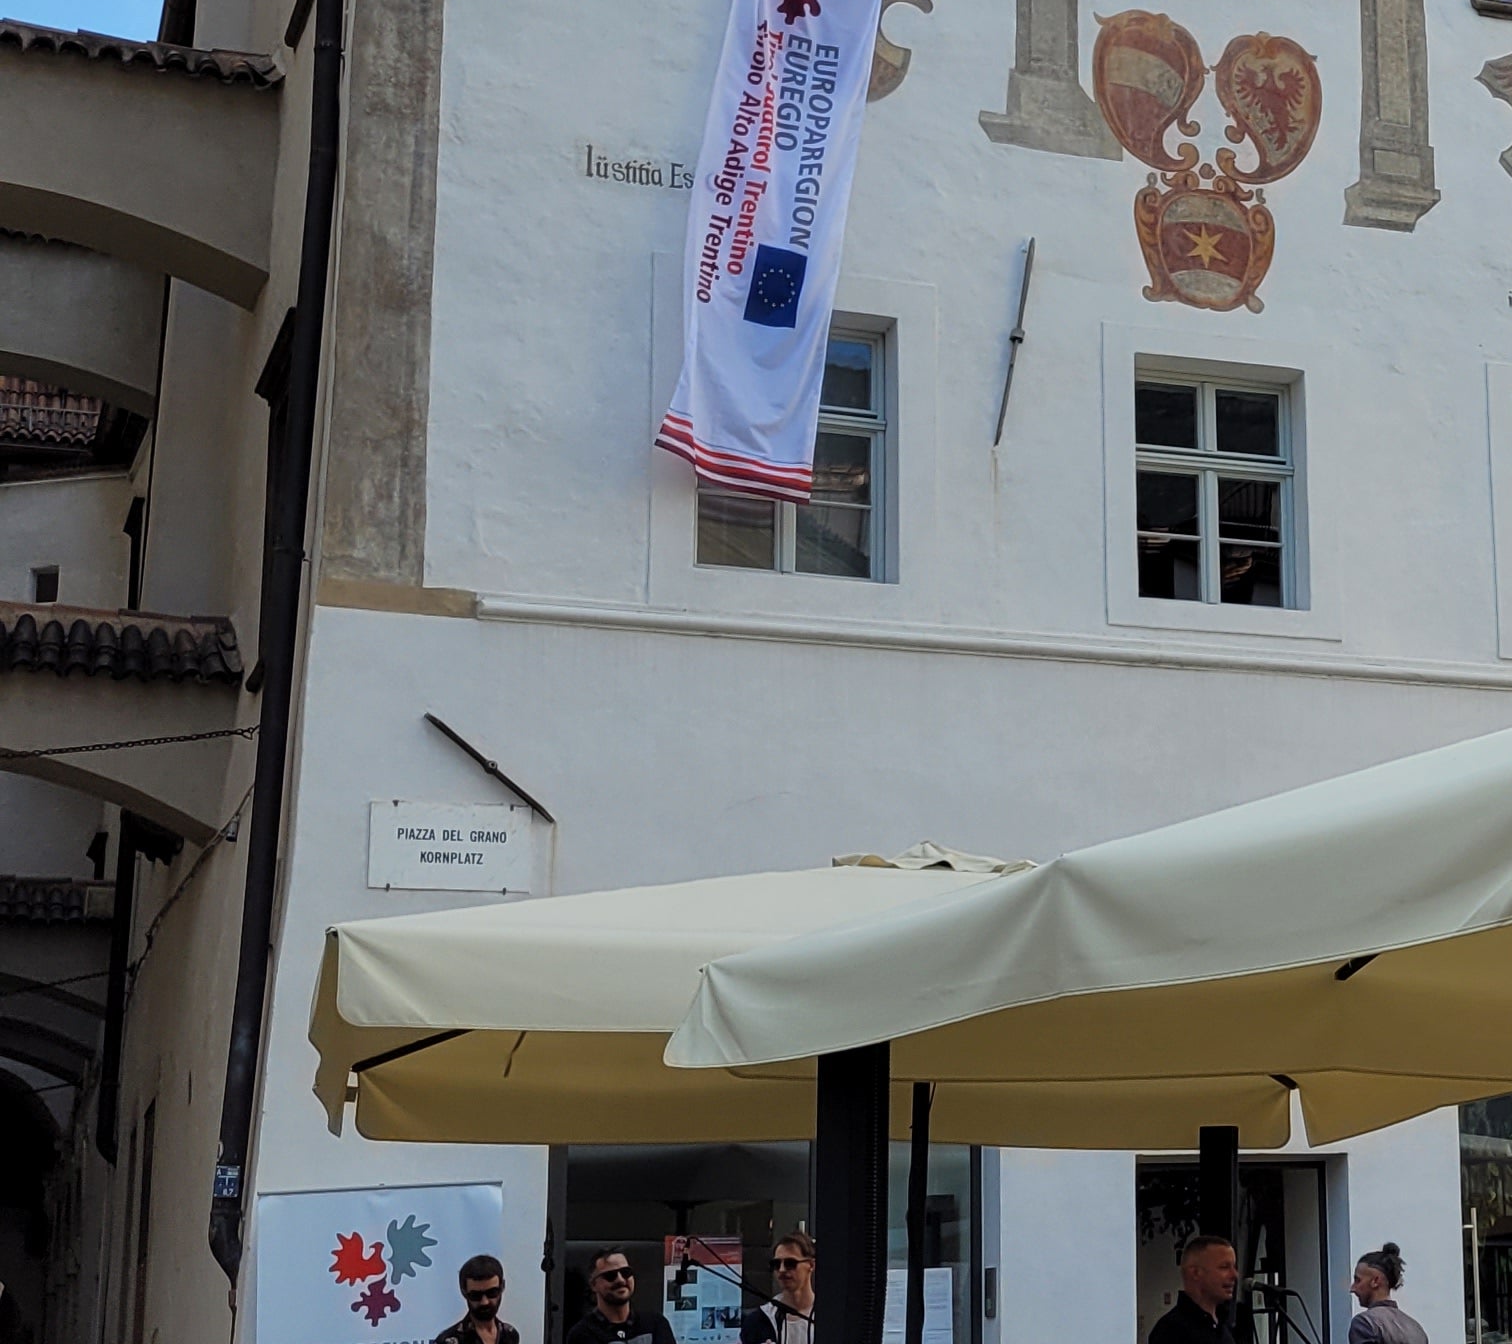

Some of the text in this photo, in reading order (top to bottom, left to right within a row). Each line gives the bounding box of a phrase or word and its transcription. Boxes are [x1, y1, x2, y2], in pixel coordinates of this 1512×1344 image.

[732, 90, 762, 137] Alto
[775, 33, 812, 152] EUREGIO
[714, 138, 749, 206] Adige
[789, 44, 840, 250] EUROPAREGION
[696, 214, 733, 304] Trentino
[727, 180, 768, 275] Trentino
[397, 827, 507, 844] PIAZZA DEL GRANO
[420, 851, 484, 866] KORNPLATZ
